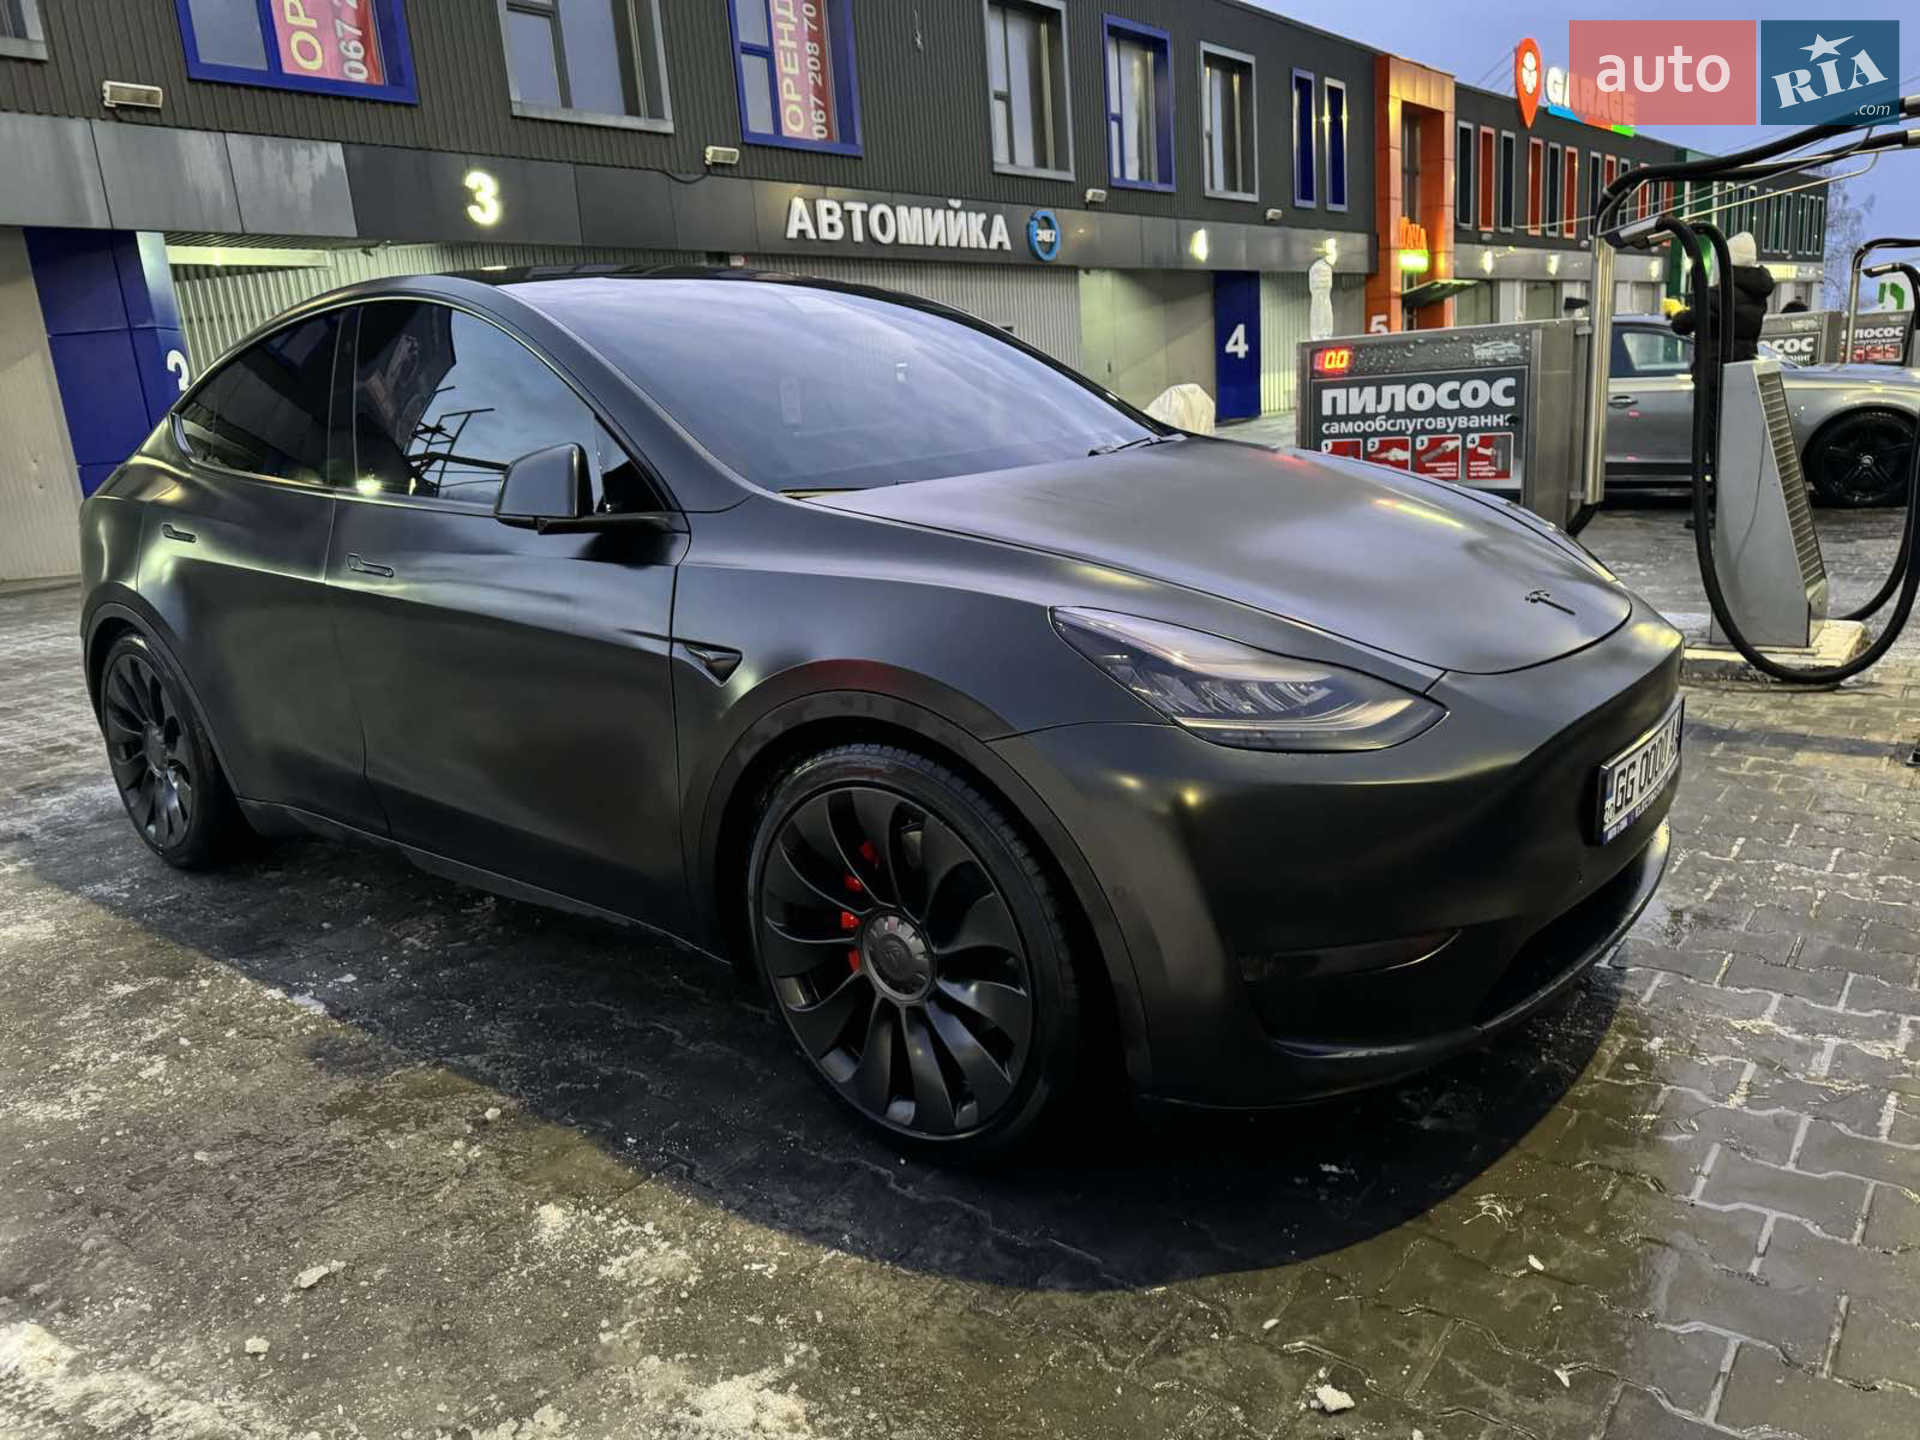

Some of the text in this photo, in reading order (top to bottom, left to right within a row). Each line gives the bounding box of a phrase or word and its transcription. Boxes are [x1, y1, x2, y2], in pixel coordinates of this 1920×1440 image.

[335, 19, 369, 81] 067
[805, 42, 822, 87] 208
[809, 94, 828, 139] 067
[1545, 66, 1635, 127] GARAGE
[464, 172, 500, 226] 3
[786, 196, 1012, 250] АВТОМИЙКА
[1225, 323, 1249, 359] 4
[1370, 314, 1389, 336] 5
[1321, 377, 1517, 416] ПИЛОСОС
[1615, 761, 1636, 814] GG
